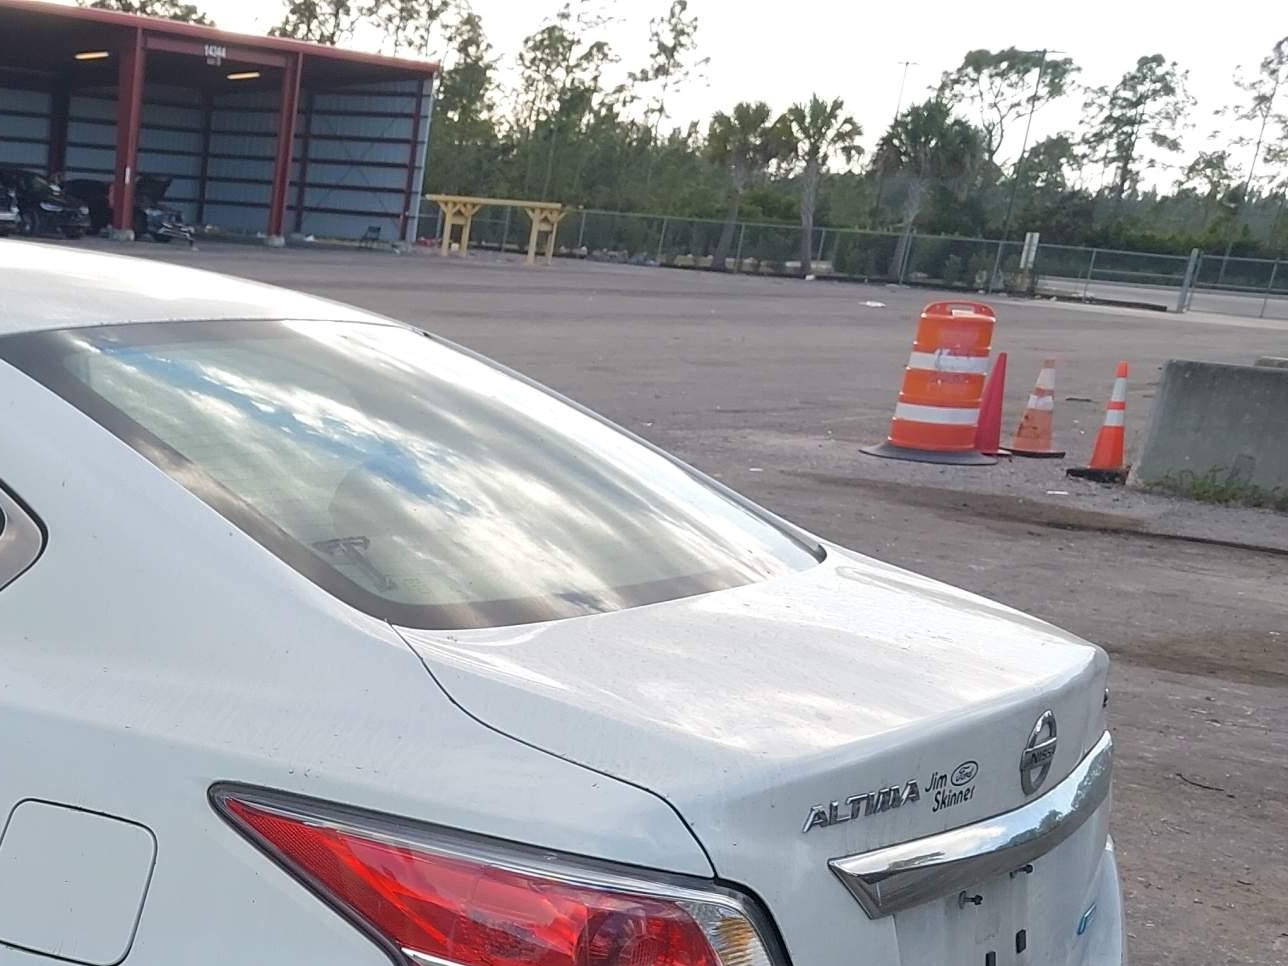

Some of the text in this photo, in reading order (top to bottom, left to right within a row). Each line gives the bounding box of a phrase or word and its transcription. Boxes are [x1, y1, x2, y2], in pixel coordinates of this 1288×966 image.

[925, 764, 976, 793] Jim Ford
[801, 778, 921, 834] ALTIMA
[932, 785, 976, 813] Skinner
